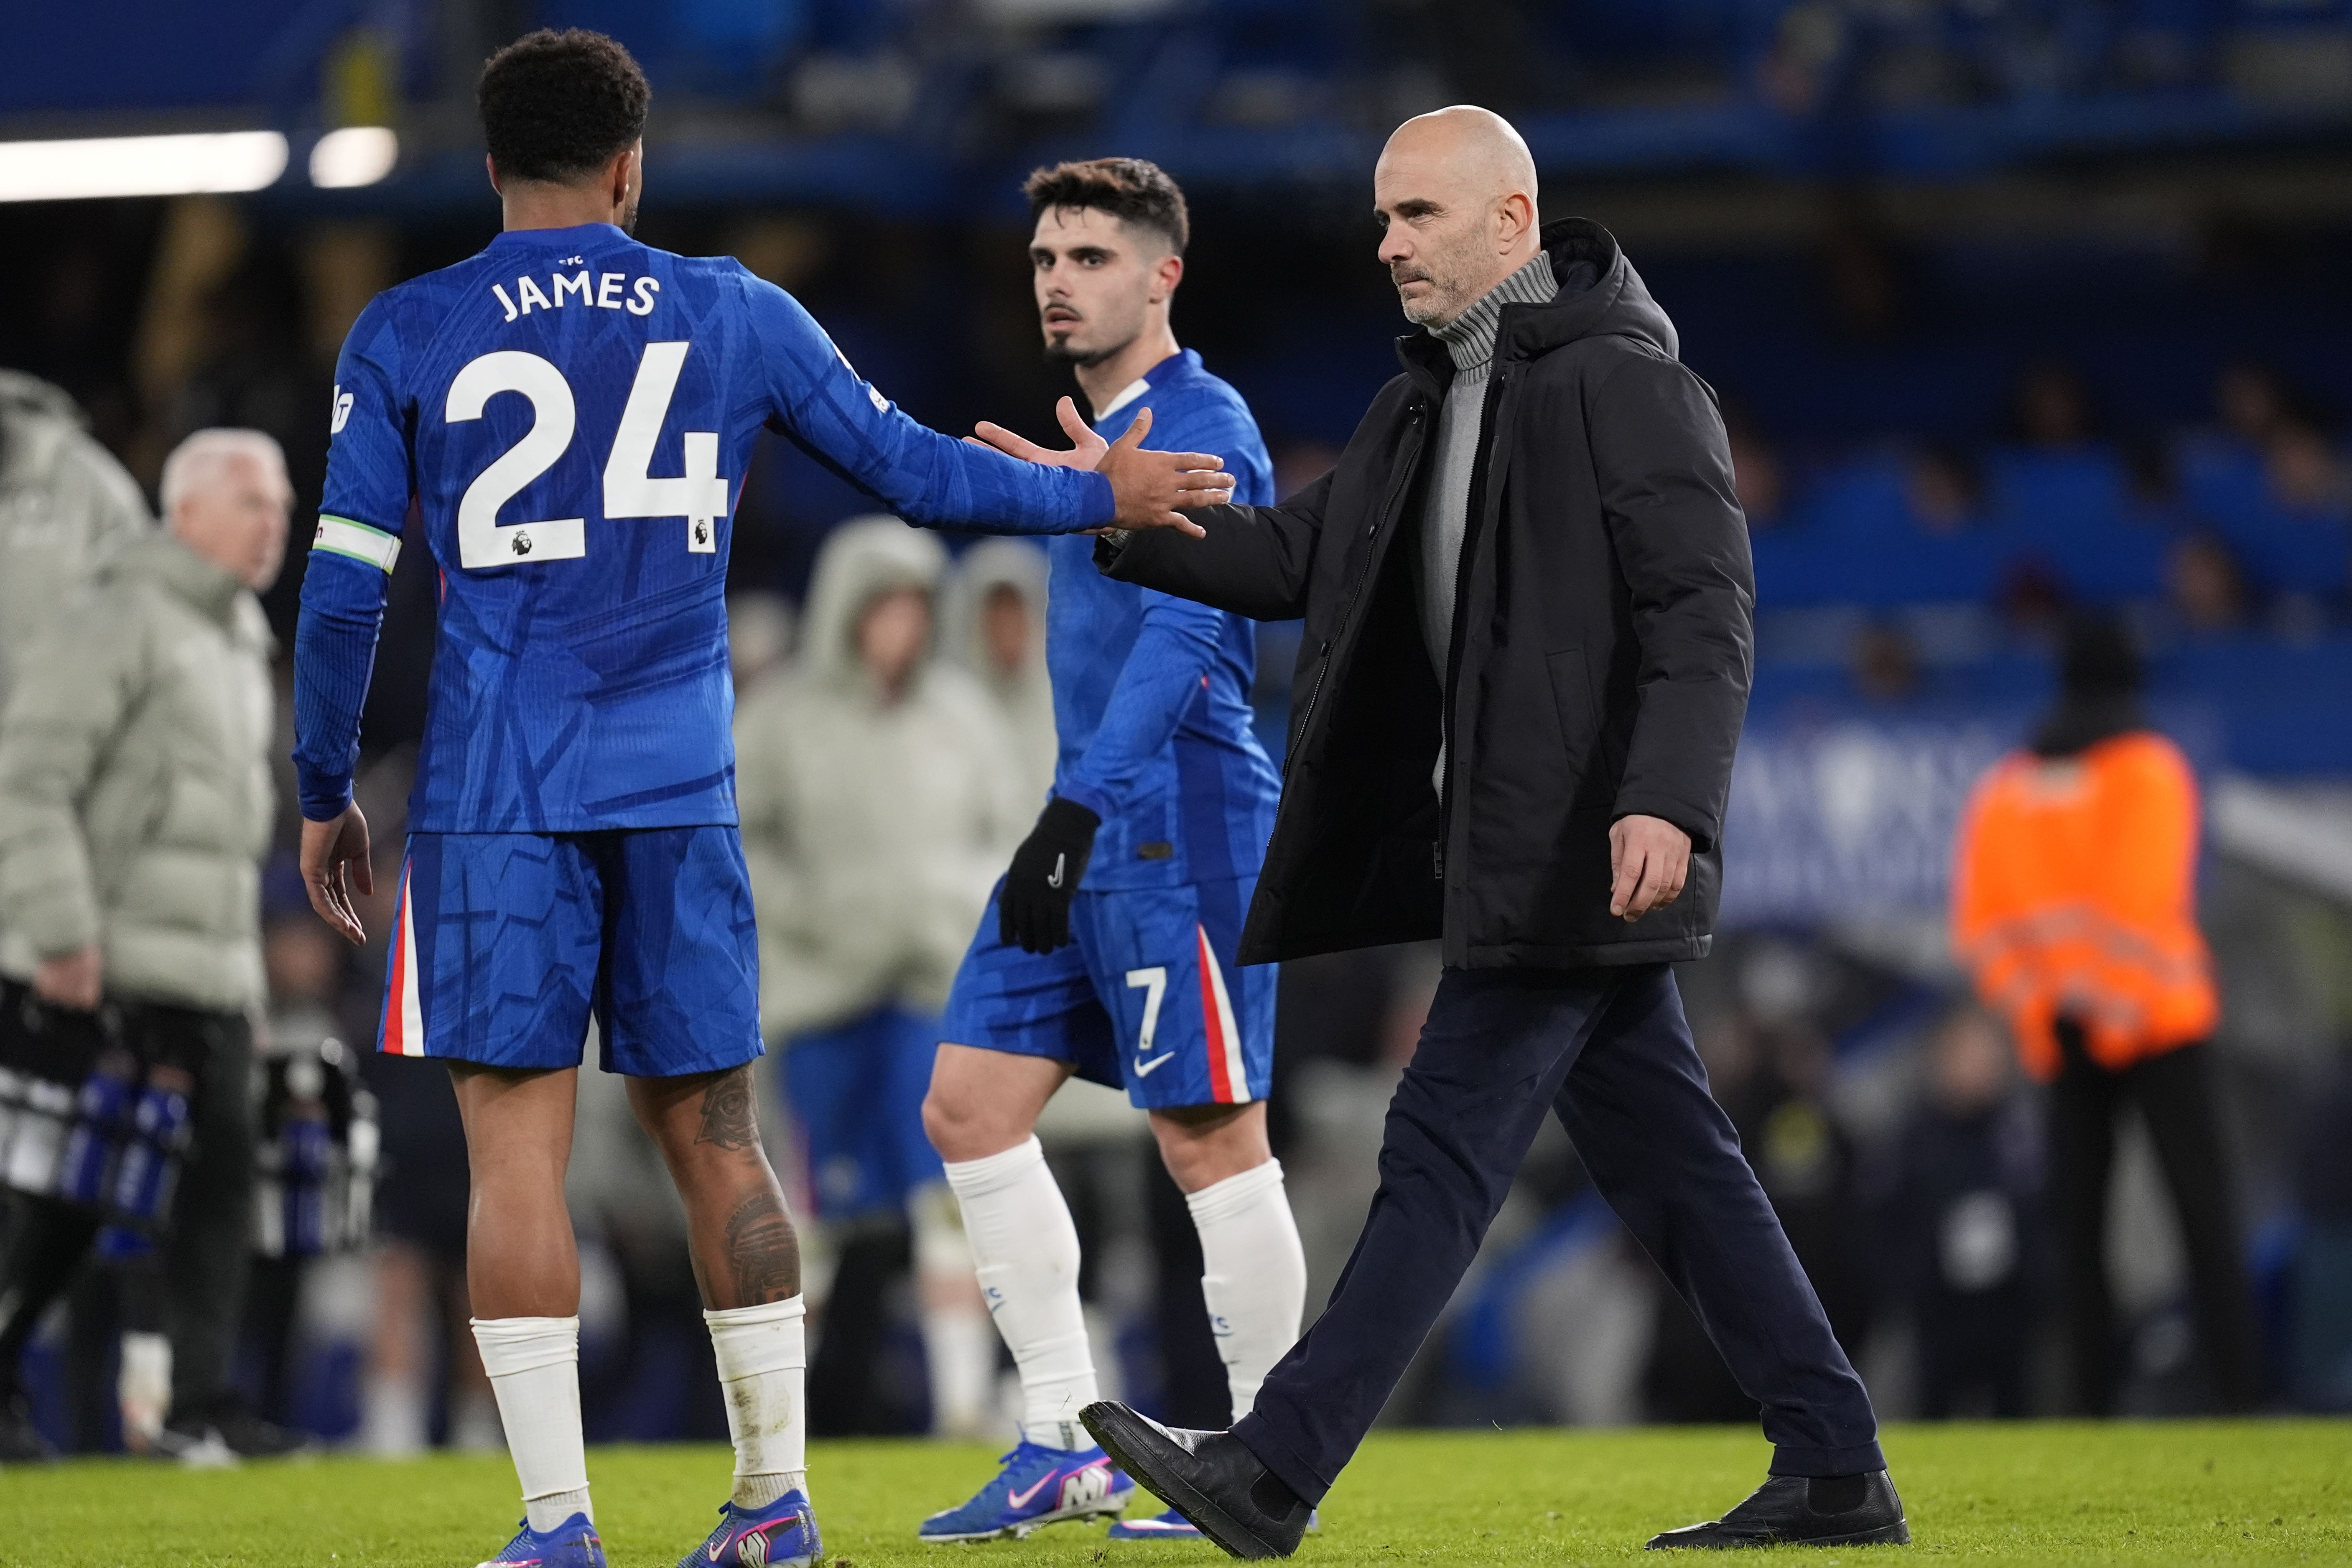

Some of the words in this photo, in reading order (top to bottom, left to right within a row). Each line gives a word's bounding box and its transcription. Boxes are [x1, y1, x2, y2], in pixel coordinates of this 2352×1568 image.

[492, 270, 660, 323] JAMES
[445, 341, 729, 569] 24
[1126, 966, 1166, 1050] 7
